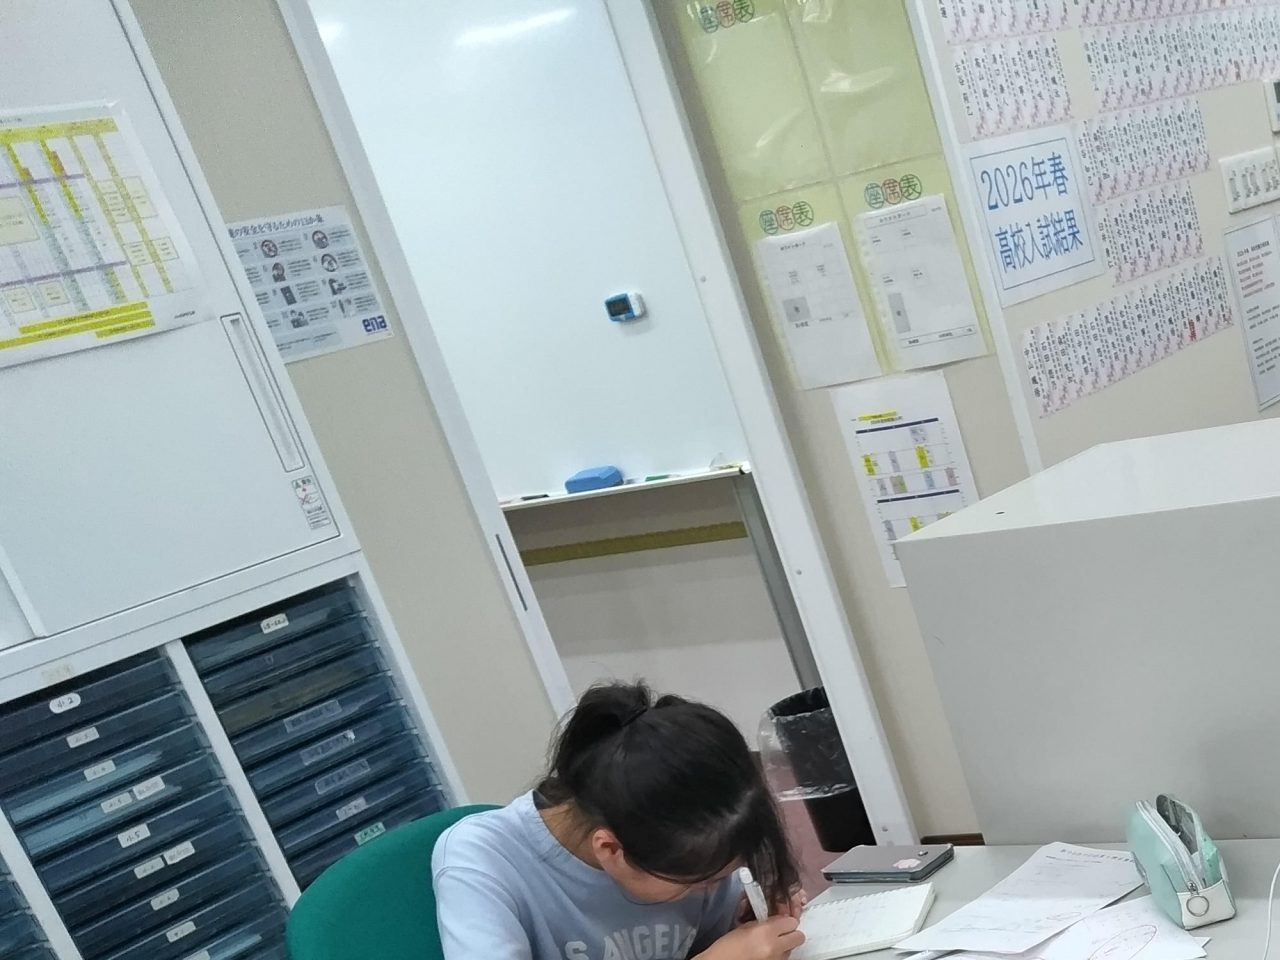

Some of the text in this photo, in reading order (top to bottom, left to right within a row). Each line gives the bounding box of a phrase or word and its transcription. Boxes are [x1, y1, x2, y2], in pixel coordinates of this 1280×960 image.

[697, 0, 755, 33] 座席表
[865, 174, 921, 209] 座席表
[981, 152, 1069, 210] 2026年春
[760, 201, 814, 235] 座席表
[995, 216, 1084, 275] 高校入試結果
[362, 315, 388, 333] ena
